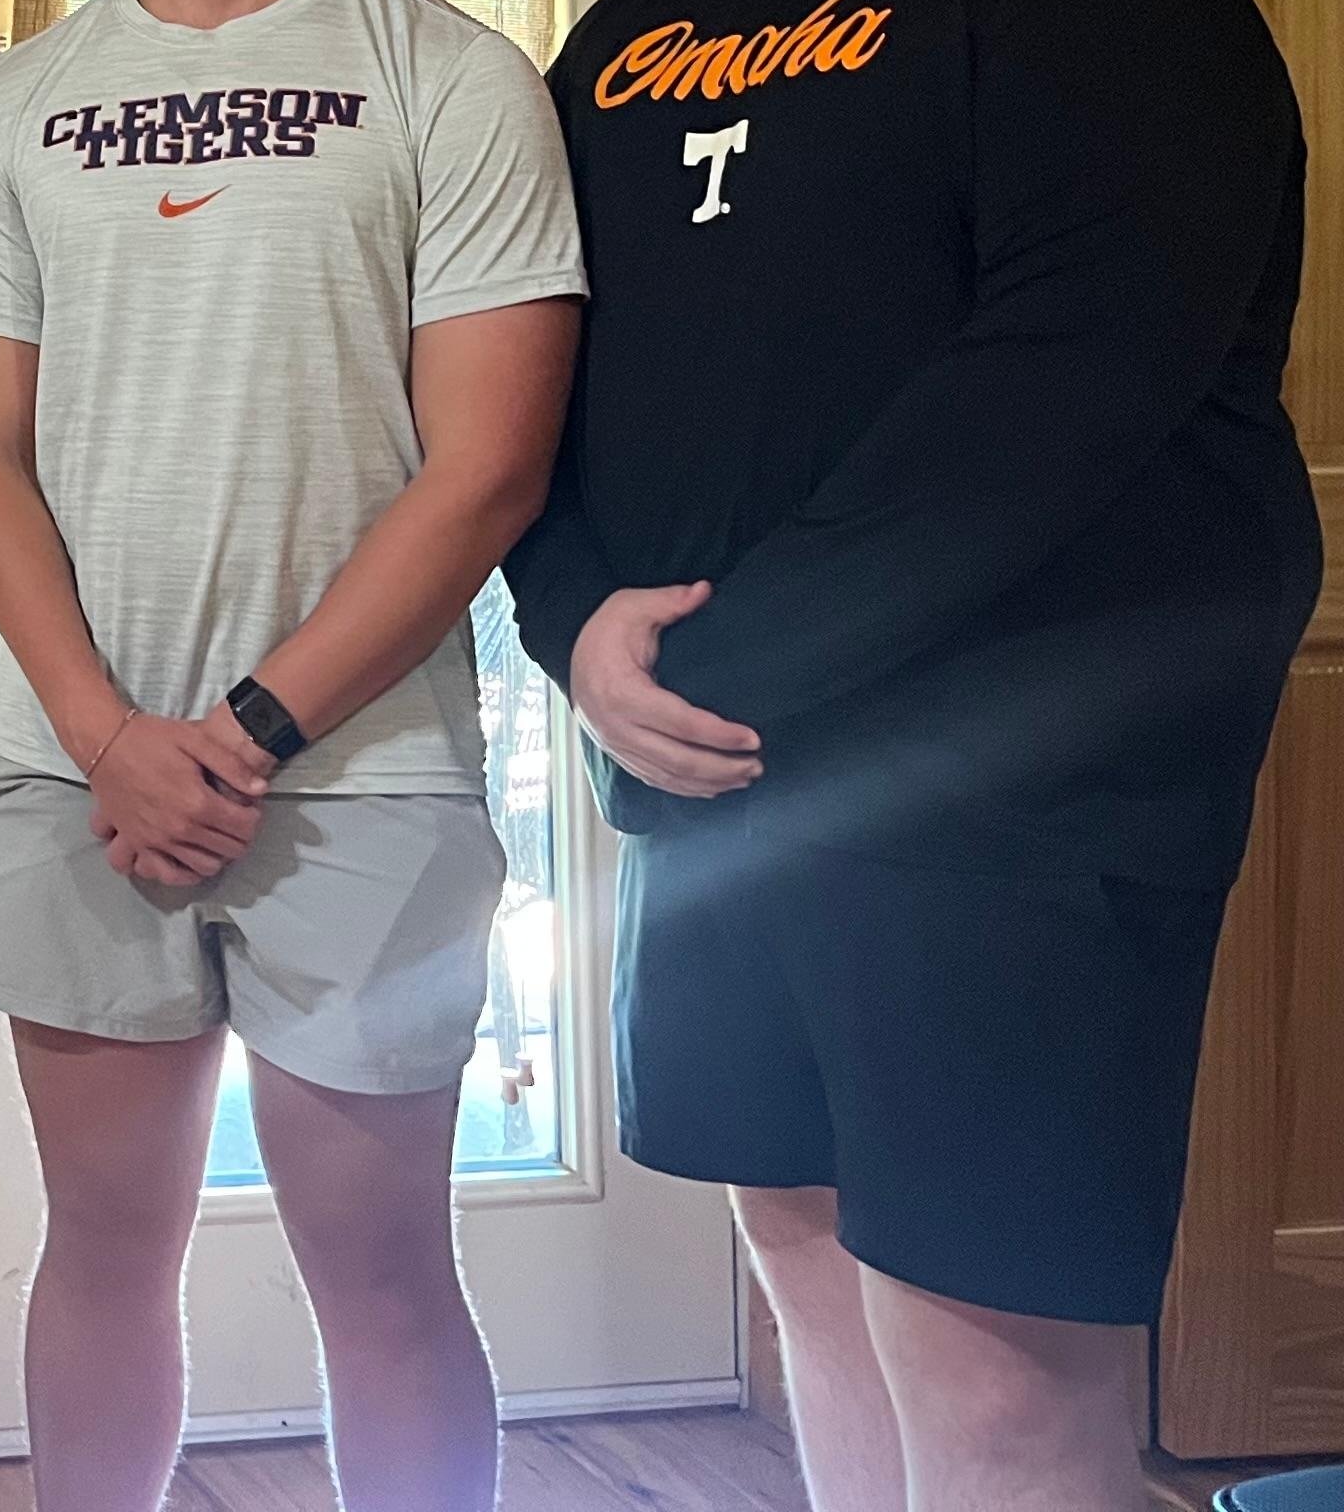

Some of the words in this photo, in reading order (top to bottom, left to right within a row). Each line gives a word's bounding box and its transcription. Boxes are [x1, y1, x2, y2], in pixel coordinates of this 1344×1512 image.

[42, 88, 367, 149] CLEMSON
[73, 120, 317, 171] TIGERS
[683, 119, 749, 223] T
